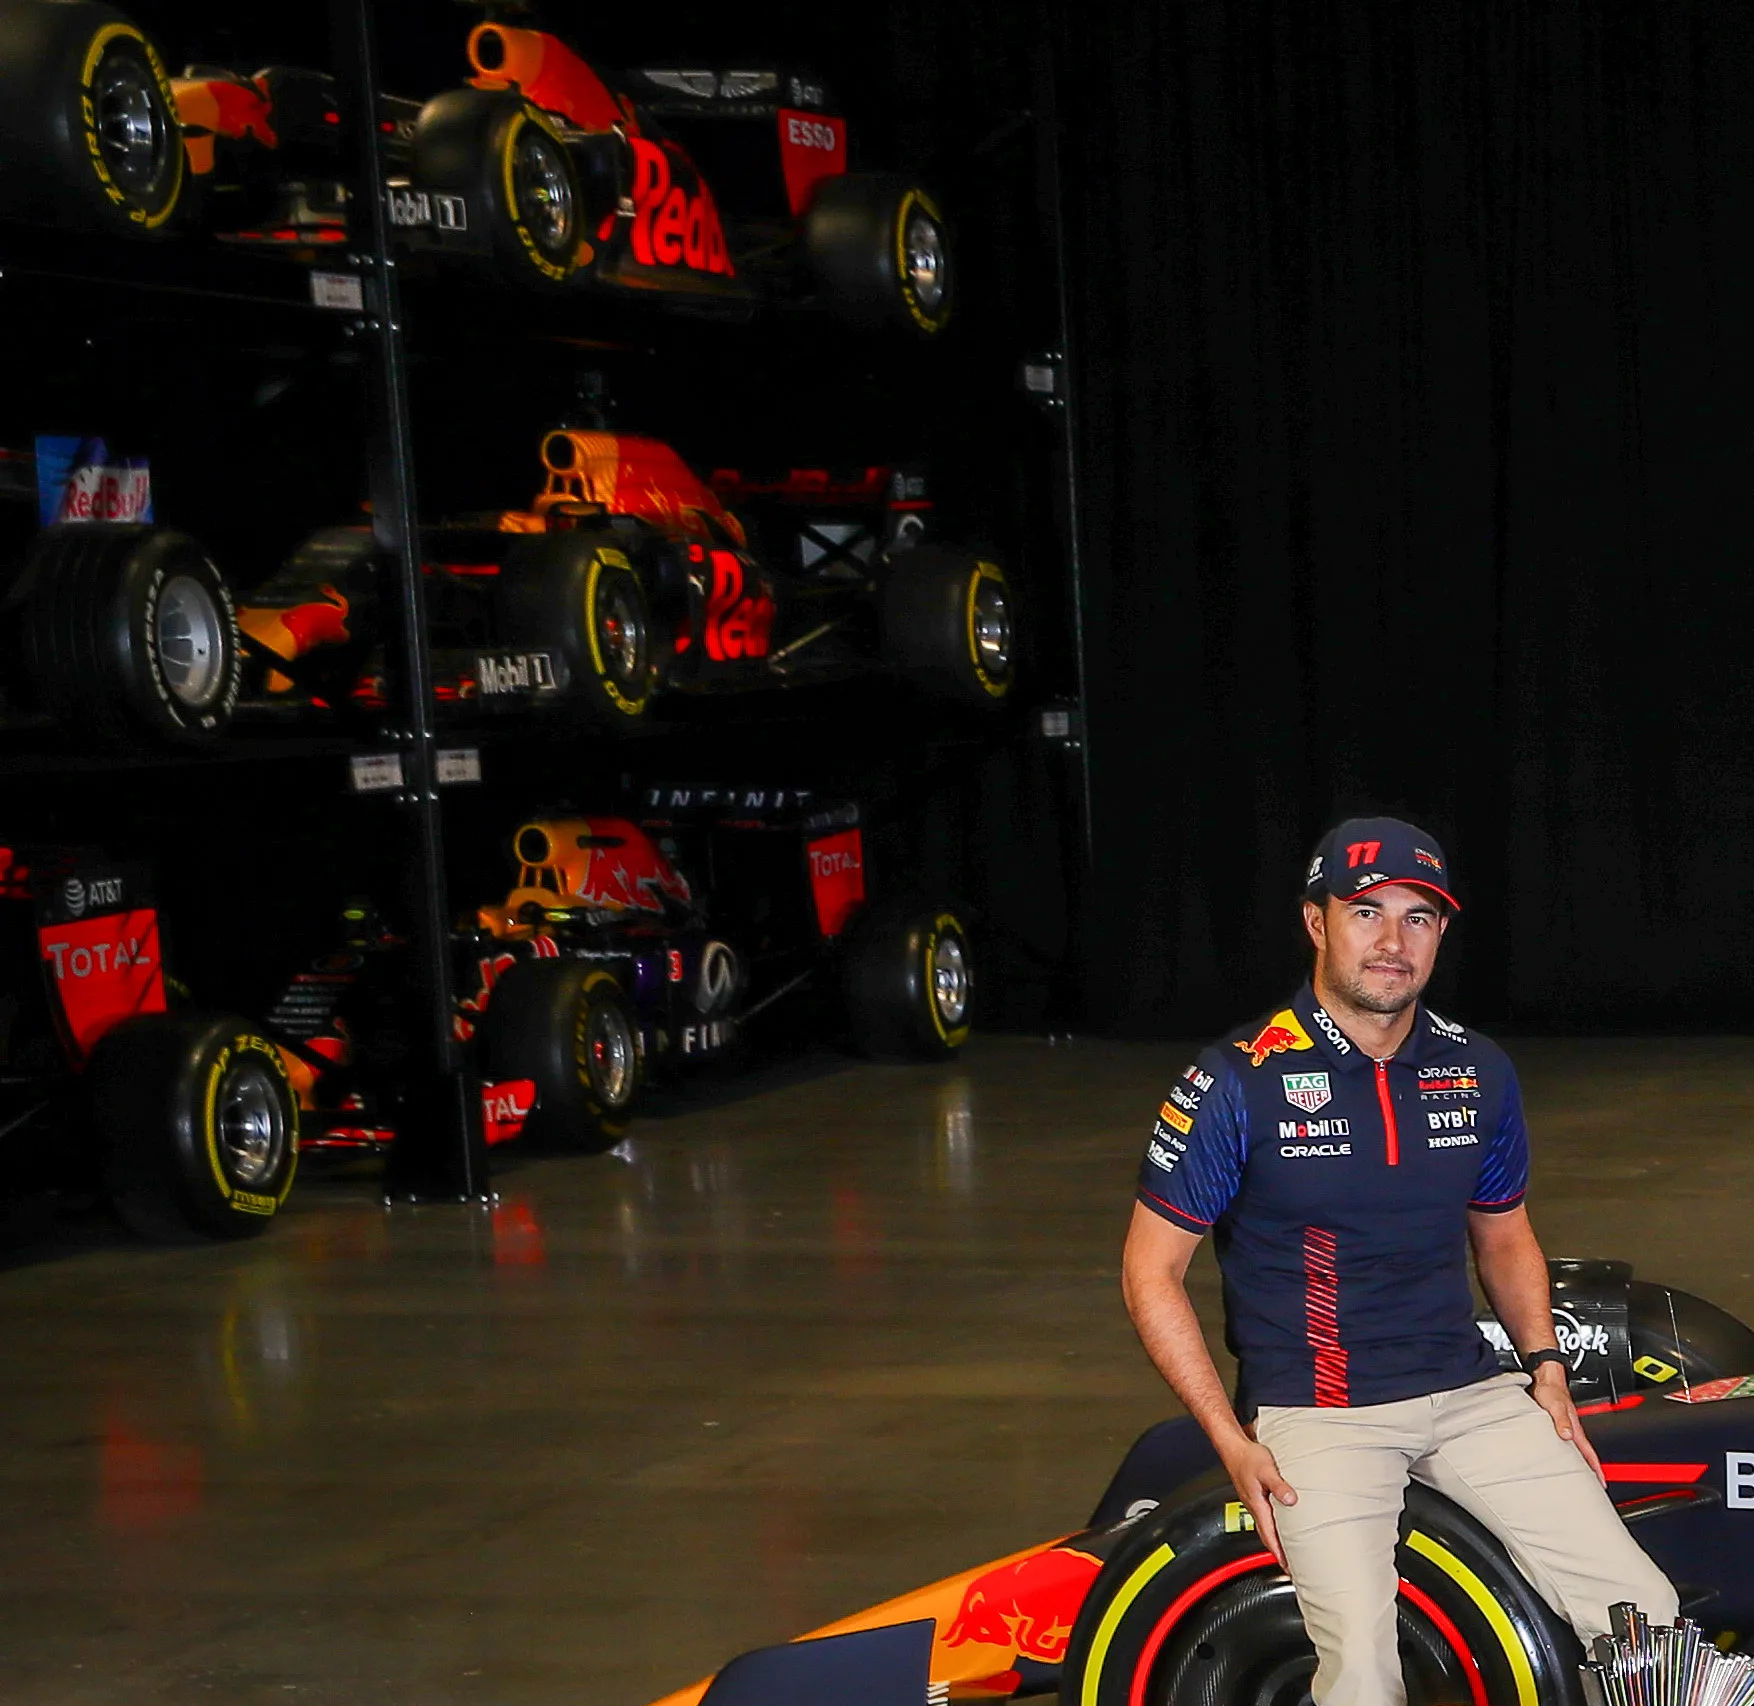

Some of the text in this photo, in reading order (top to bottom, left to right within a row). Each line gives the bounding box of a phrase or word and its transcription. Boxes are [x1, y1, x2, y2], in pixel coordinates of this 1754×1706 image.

[788, 118, 835, 151] ESSO
[386, 188, 431, 225] obil
[479, 656, 528, 695] Mobil
[810, 850, 861, 877] TOTAL
[1346, 841, 1382, 869] 11
[89, 878, 123, 905] AT&T
[47, 936, 151, 980] TOTAL
[1312, 1008, 1352, 1055] zoom
[1288, 1076, 1325, 1089] TAG
[1417, 1066, 1477, 1079] ORACLE
[484, 1094, 528, 1123] TAL
[1288, 1090, 1328, 1111] HEUER
[1420, 1091, 1481, 1101] RACING
[1279, 1121, 1330, 1139] Mobil
[1427, 1106, 1478, 1130] BYBIT
[1280, 1143, 1352, 1158] ORACLE
[1427, 1134, 1479, 1149] HONDA
